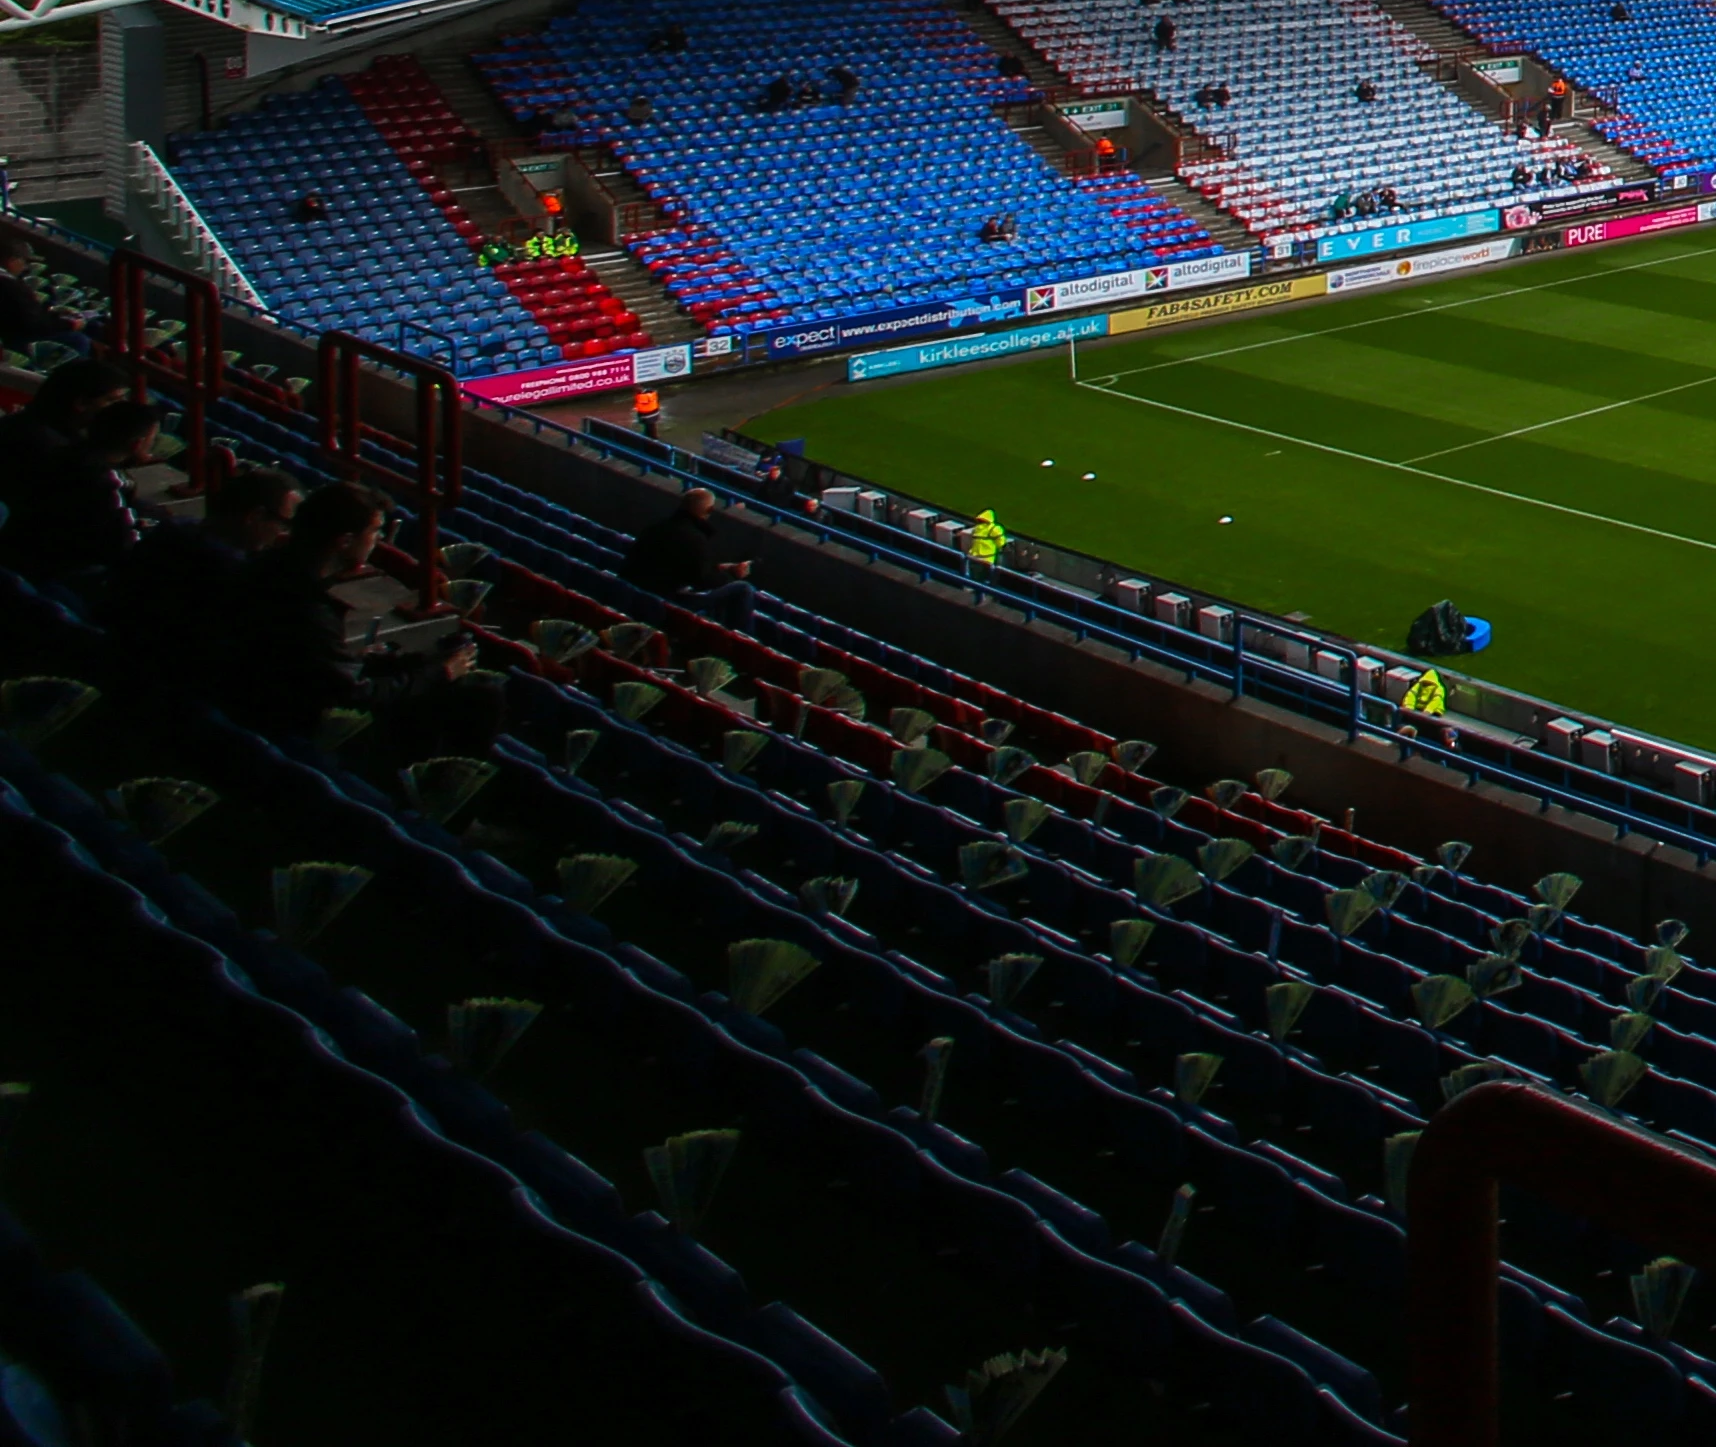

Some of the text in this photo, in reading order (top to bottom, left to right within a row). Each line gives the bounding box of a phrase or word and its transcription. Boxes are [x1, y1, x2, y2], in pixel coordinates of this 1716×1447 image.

[1568, 224, 1604, 245] PURE
[1174, 255, 1242, 277] altodigital
[1412, 248, 1490, 272] fireplaceworld
[1060, 274, 1133, 297] altodigital
[1146, 282, 1293, 319] FAB4SAFETY.COM
[842, 298, 1021, 338] www.expectdistribution.com
[708, 339, 728, 351] 32
[775, 326, 836, 349] expect
